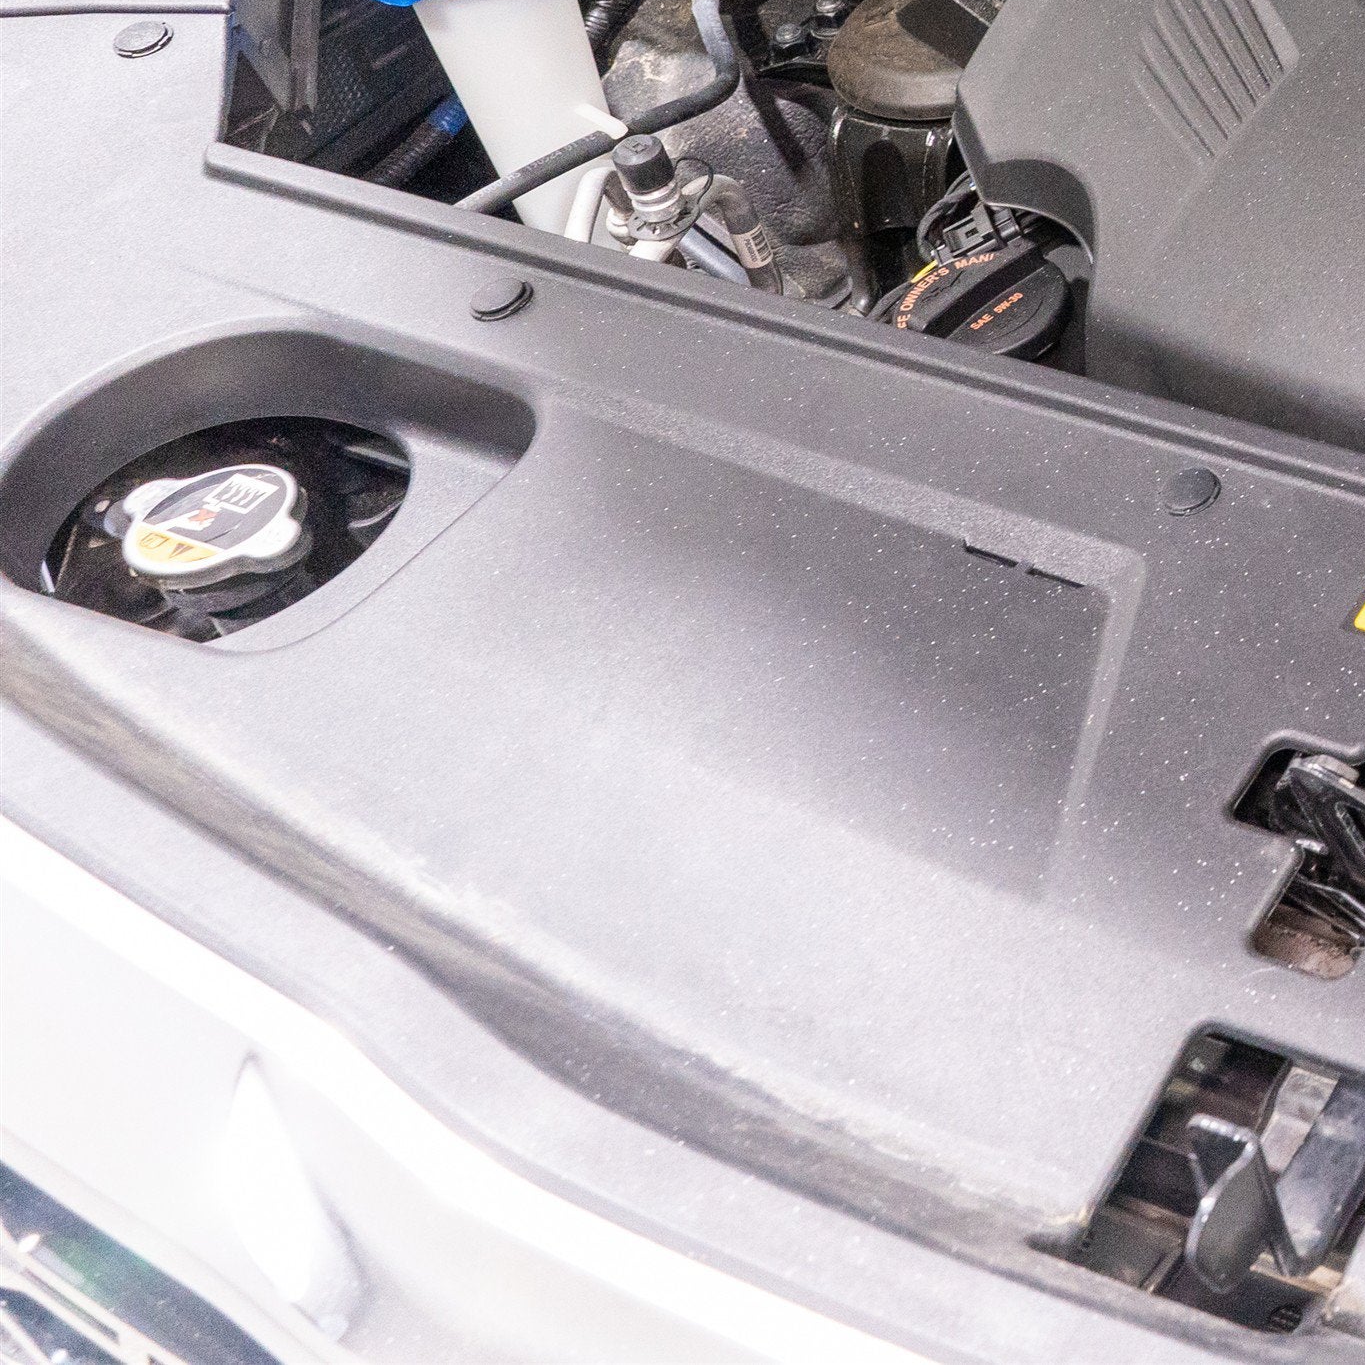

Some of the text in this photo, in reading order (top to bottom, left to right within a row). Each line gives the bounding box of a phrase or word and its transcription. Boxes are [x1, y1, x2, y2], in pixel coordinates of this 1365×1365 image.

[900, 267, 950, 312] OWNER'S
[970, 292, 1024, 330] SAE 5W-30
